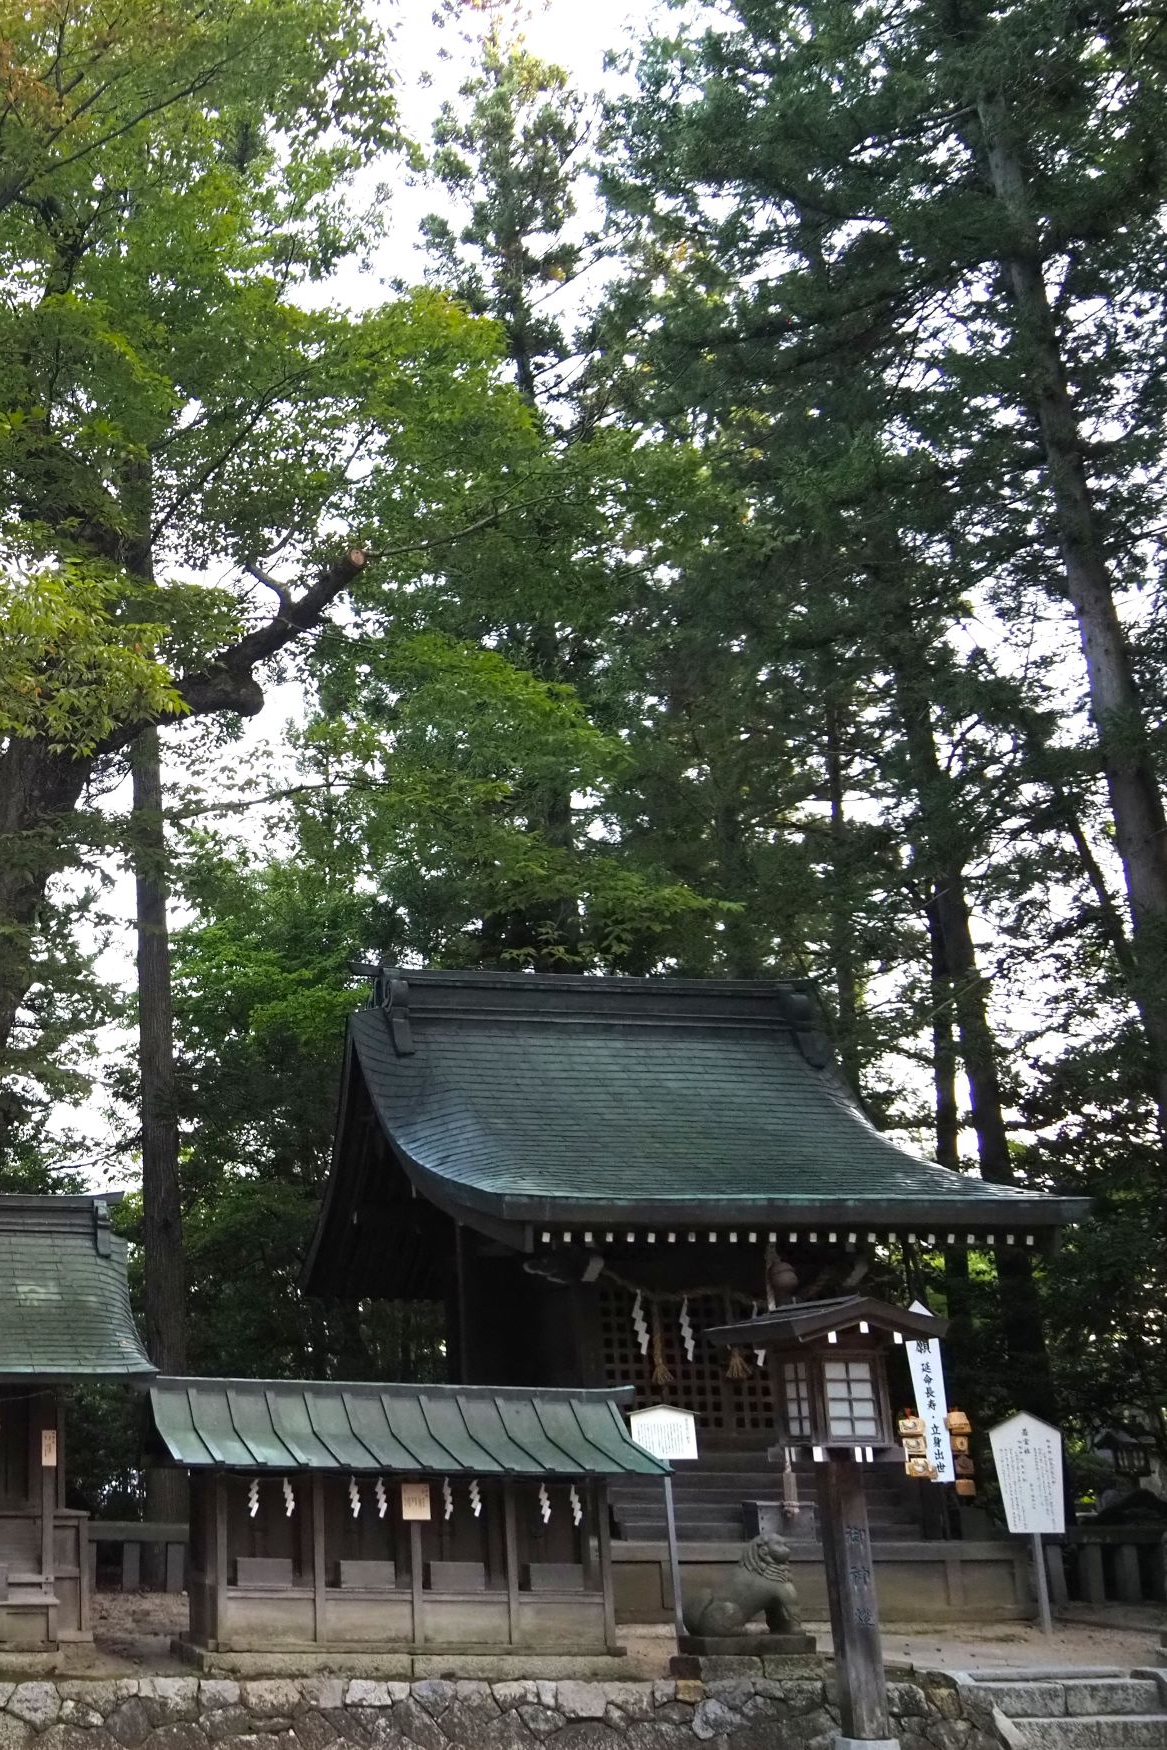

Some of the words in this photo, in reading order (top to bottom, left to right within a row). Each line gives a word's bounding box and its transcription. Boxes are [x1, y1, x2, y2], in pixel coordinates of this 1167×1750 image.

[921, 1361, 947, 1473] 延命長寿・立身出世
